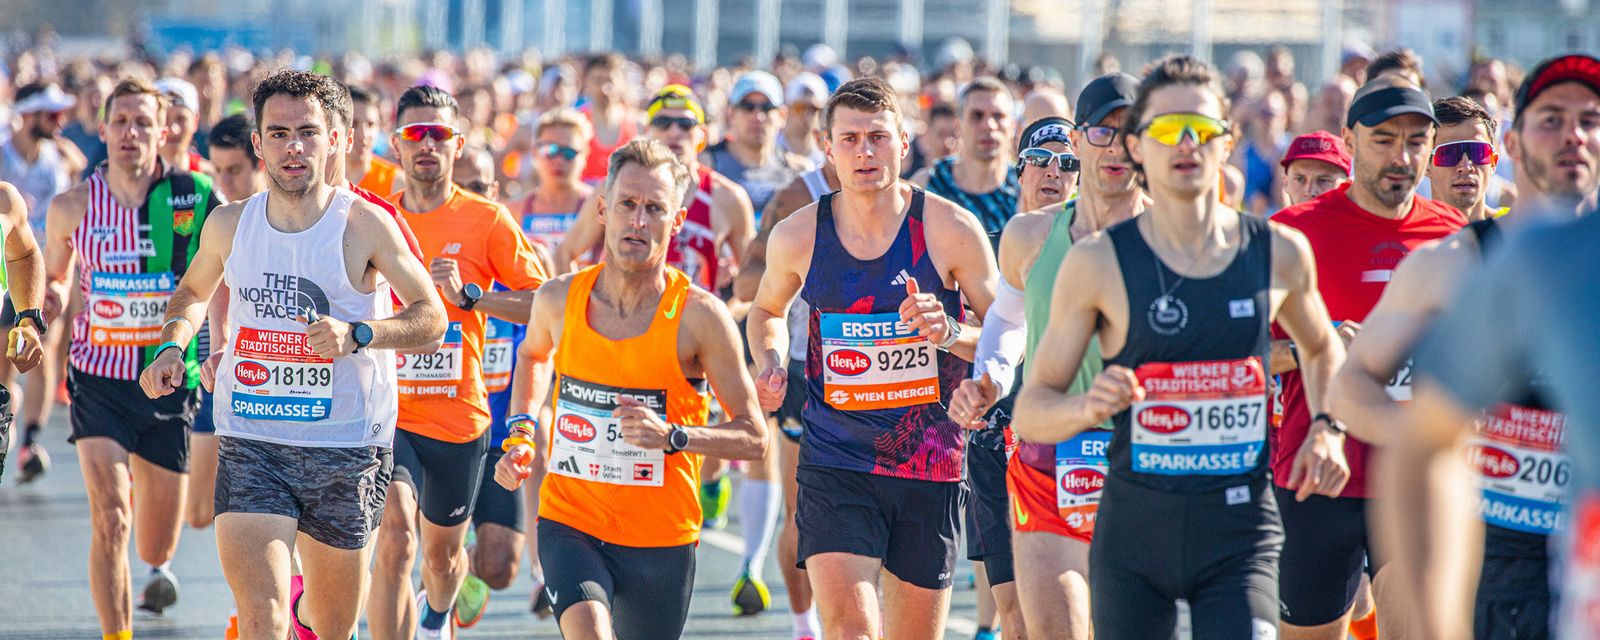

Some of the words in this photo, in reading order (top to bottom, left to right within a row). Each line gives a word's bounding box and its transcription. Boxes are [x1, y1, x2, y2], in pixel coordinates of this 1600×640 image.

[94, 276, 158, 291] SPARKASSE
[263, 272, 297, 291] THE
[238, 287, 297, 307] NORTH
[255, 303, 297, 322] FACE
[257, 331, 302, 346] WIENER
[841, 321, 893, 338] ERSTE
[240, 339, 301, 355] STÄDTISCHE
[412, 352, 453, 370] 2921
[830, 354, 868, 371] Hervis
[877, 345, 930, 372] 9225
[236, 364, 267, 383] Hervis
[271, 366, 331, 387] 18139
[1172, 363, 1230, 379] WIENER
[853, 391, 885, 403] WIEN
[887, 385, 936, 402] ENERGIE
[234, 400, 310, 418] SPARKASSE
[1193, 403, 1262, 431] 16657
[560, 417, 594, 439] Hervis
[1138, 451, 1241, 471] SPARKASSE
[1065, 473, 1104, 490] Hervis
